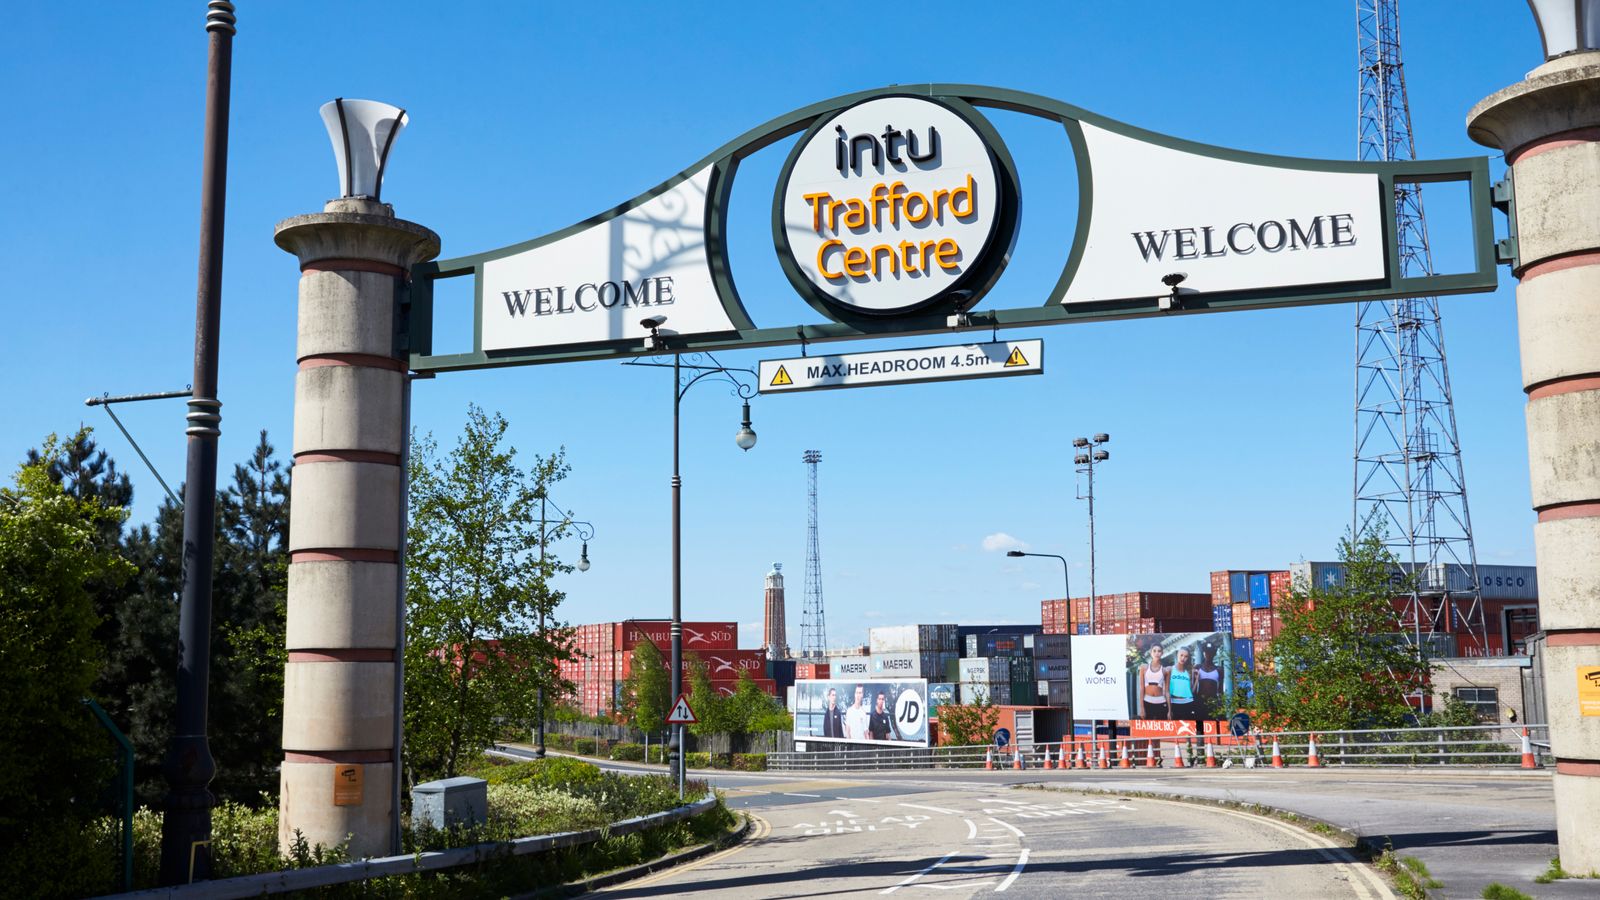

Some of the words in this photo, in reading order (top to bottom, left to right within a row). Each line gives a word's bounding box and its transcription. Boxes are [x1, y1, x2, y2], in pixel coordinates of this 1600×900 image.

[834, 123, 938, 172] intu
[802, 173, 975, 233] Trafford
[1131, 213, 1357, 263] WELCOME
[816, 237, 960, 279] Centre
[502, 275, 676, 319] WELCOME
[950, 353, 990, 368] 4.5m
[711, 630, 732, 641] SÜD
[738, 658, 761, 670] SÜD
[840, 664, 868, 673] MAERSK
[882, 659, 914, 670] MAERSK
[1085, 677, 1117, 685] WOMEN
[898, 700, 920, 724] JD
[1135, 719, 1175, 732] HAMBURG
